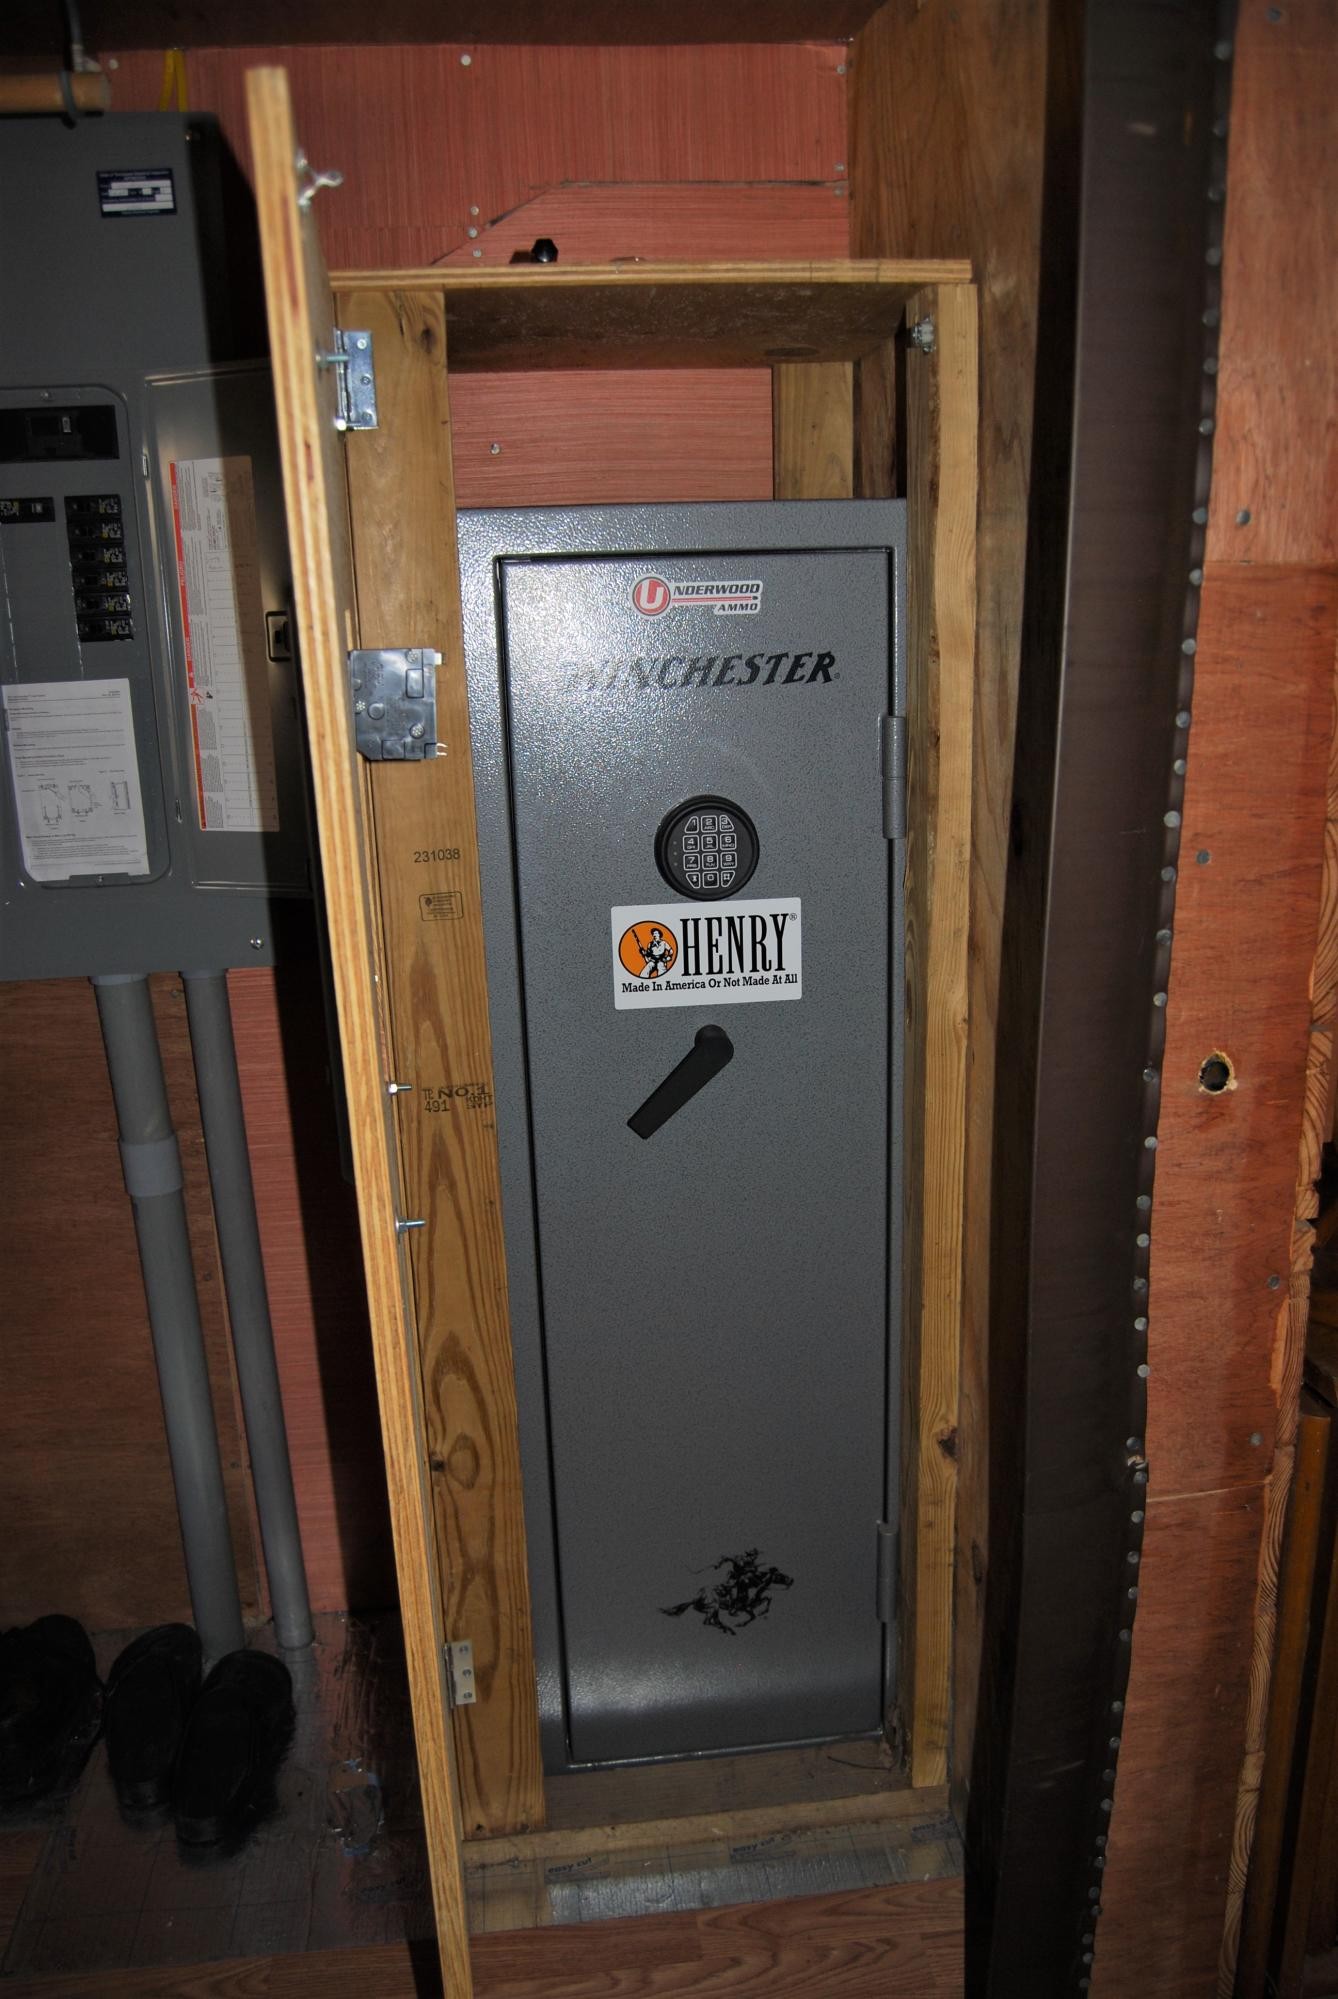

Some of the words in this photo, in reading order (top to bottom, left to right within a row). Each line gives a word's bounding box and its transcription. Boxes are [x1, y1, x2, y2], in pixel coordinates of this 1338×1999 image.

[717, 603, 758, 612] AMMO
[572, 651, 836, 690] INCHESTER
[413, 848, 461, 863] 231038
[680, 913, 789, 977] HENRY
[622, 982, 650, 993] Made
[652, 981, 663, 991] In
[665, 979, 706, 991] America
[708, 978, 721, 988] Or
[723, 977, 741, 987] Not
[742, 975, 770, 986] Made
[772, 974, 783, 984] At
[784, 973, 798, 984] All
[424, 1099, 450, 1112] 491
[547, 1863, 574, 1874] easy
[576, 1856, 593, 1867] cut
